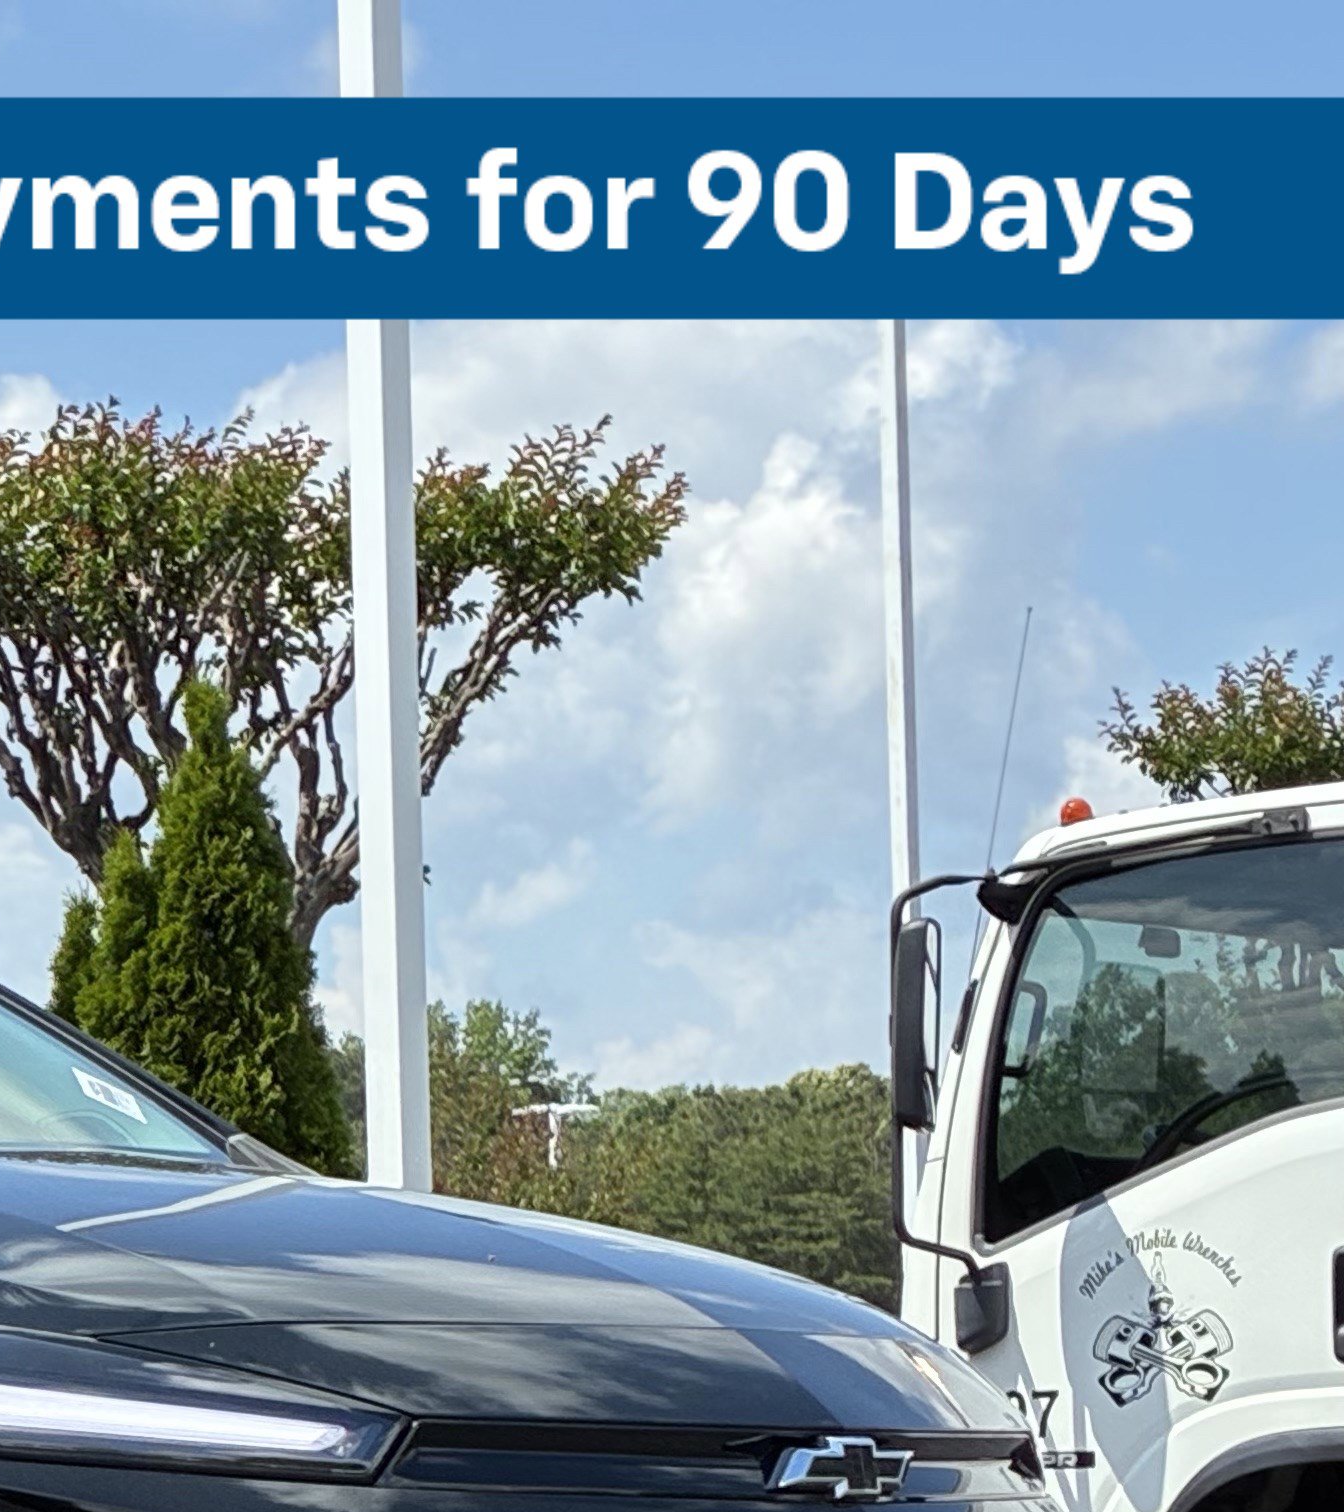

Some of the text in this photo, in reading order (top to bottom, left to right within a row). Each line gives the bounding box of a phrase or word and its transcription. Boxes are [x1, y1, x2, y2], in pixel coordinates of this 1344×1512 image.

[1078, 1229, 1242, 1300] Mike's Mobile Wrenches
